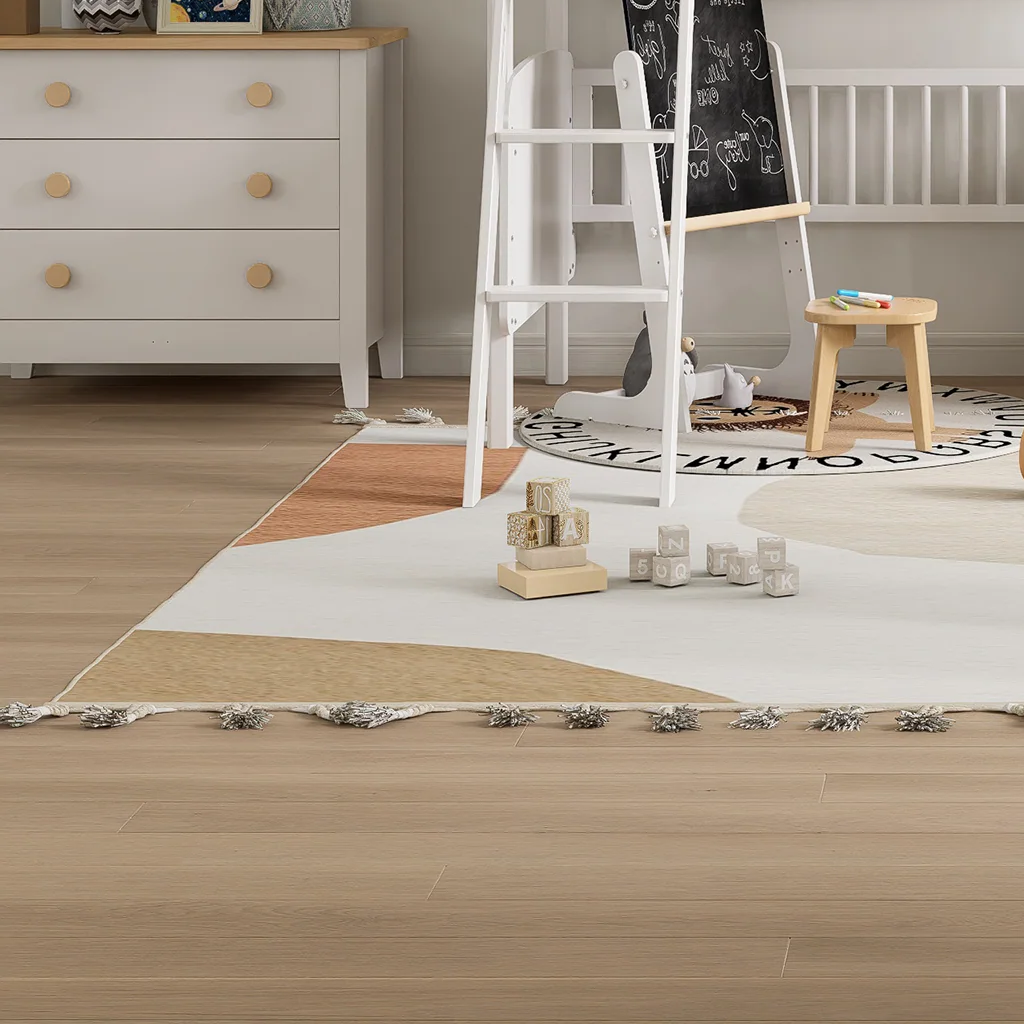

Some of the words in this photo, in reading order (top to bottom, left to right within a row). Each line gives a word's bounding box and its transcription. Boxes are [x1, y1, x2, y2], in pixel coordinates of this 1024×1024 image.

[561, 518, 580, 541] A
[636, 559, 649, 575] 5
[781, 573, 794, 590] K
